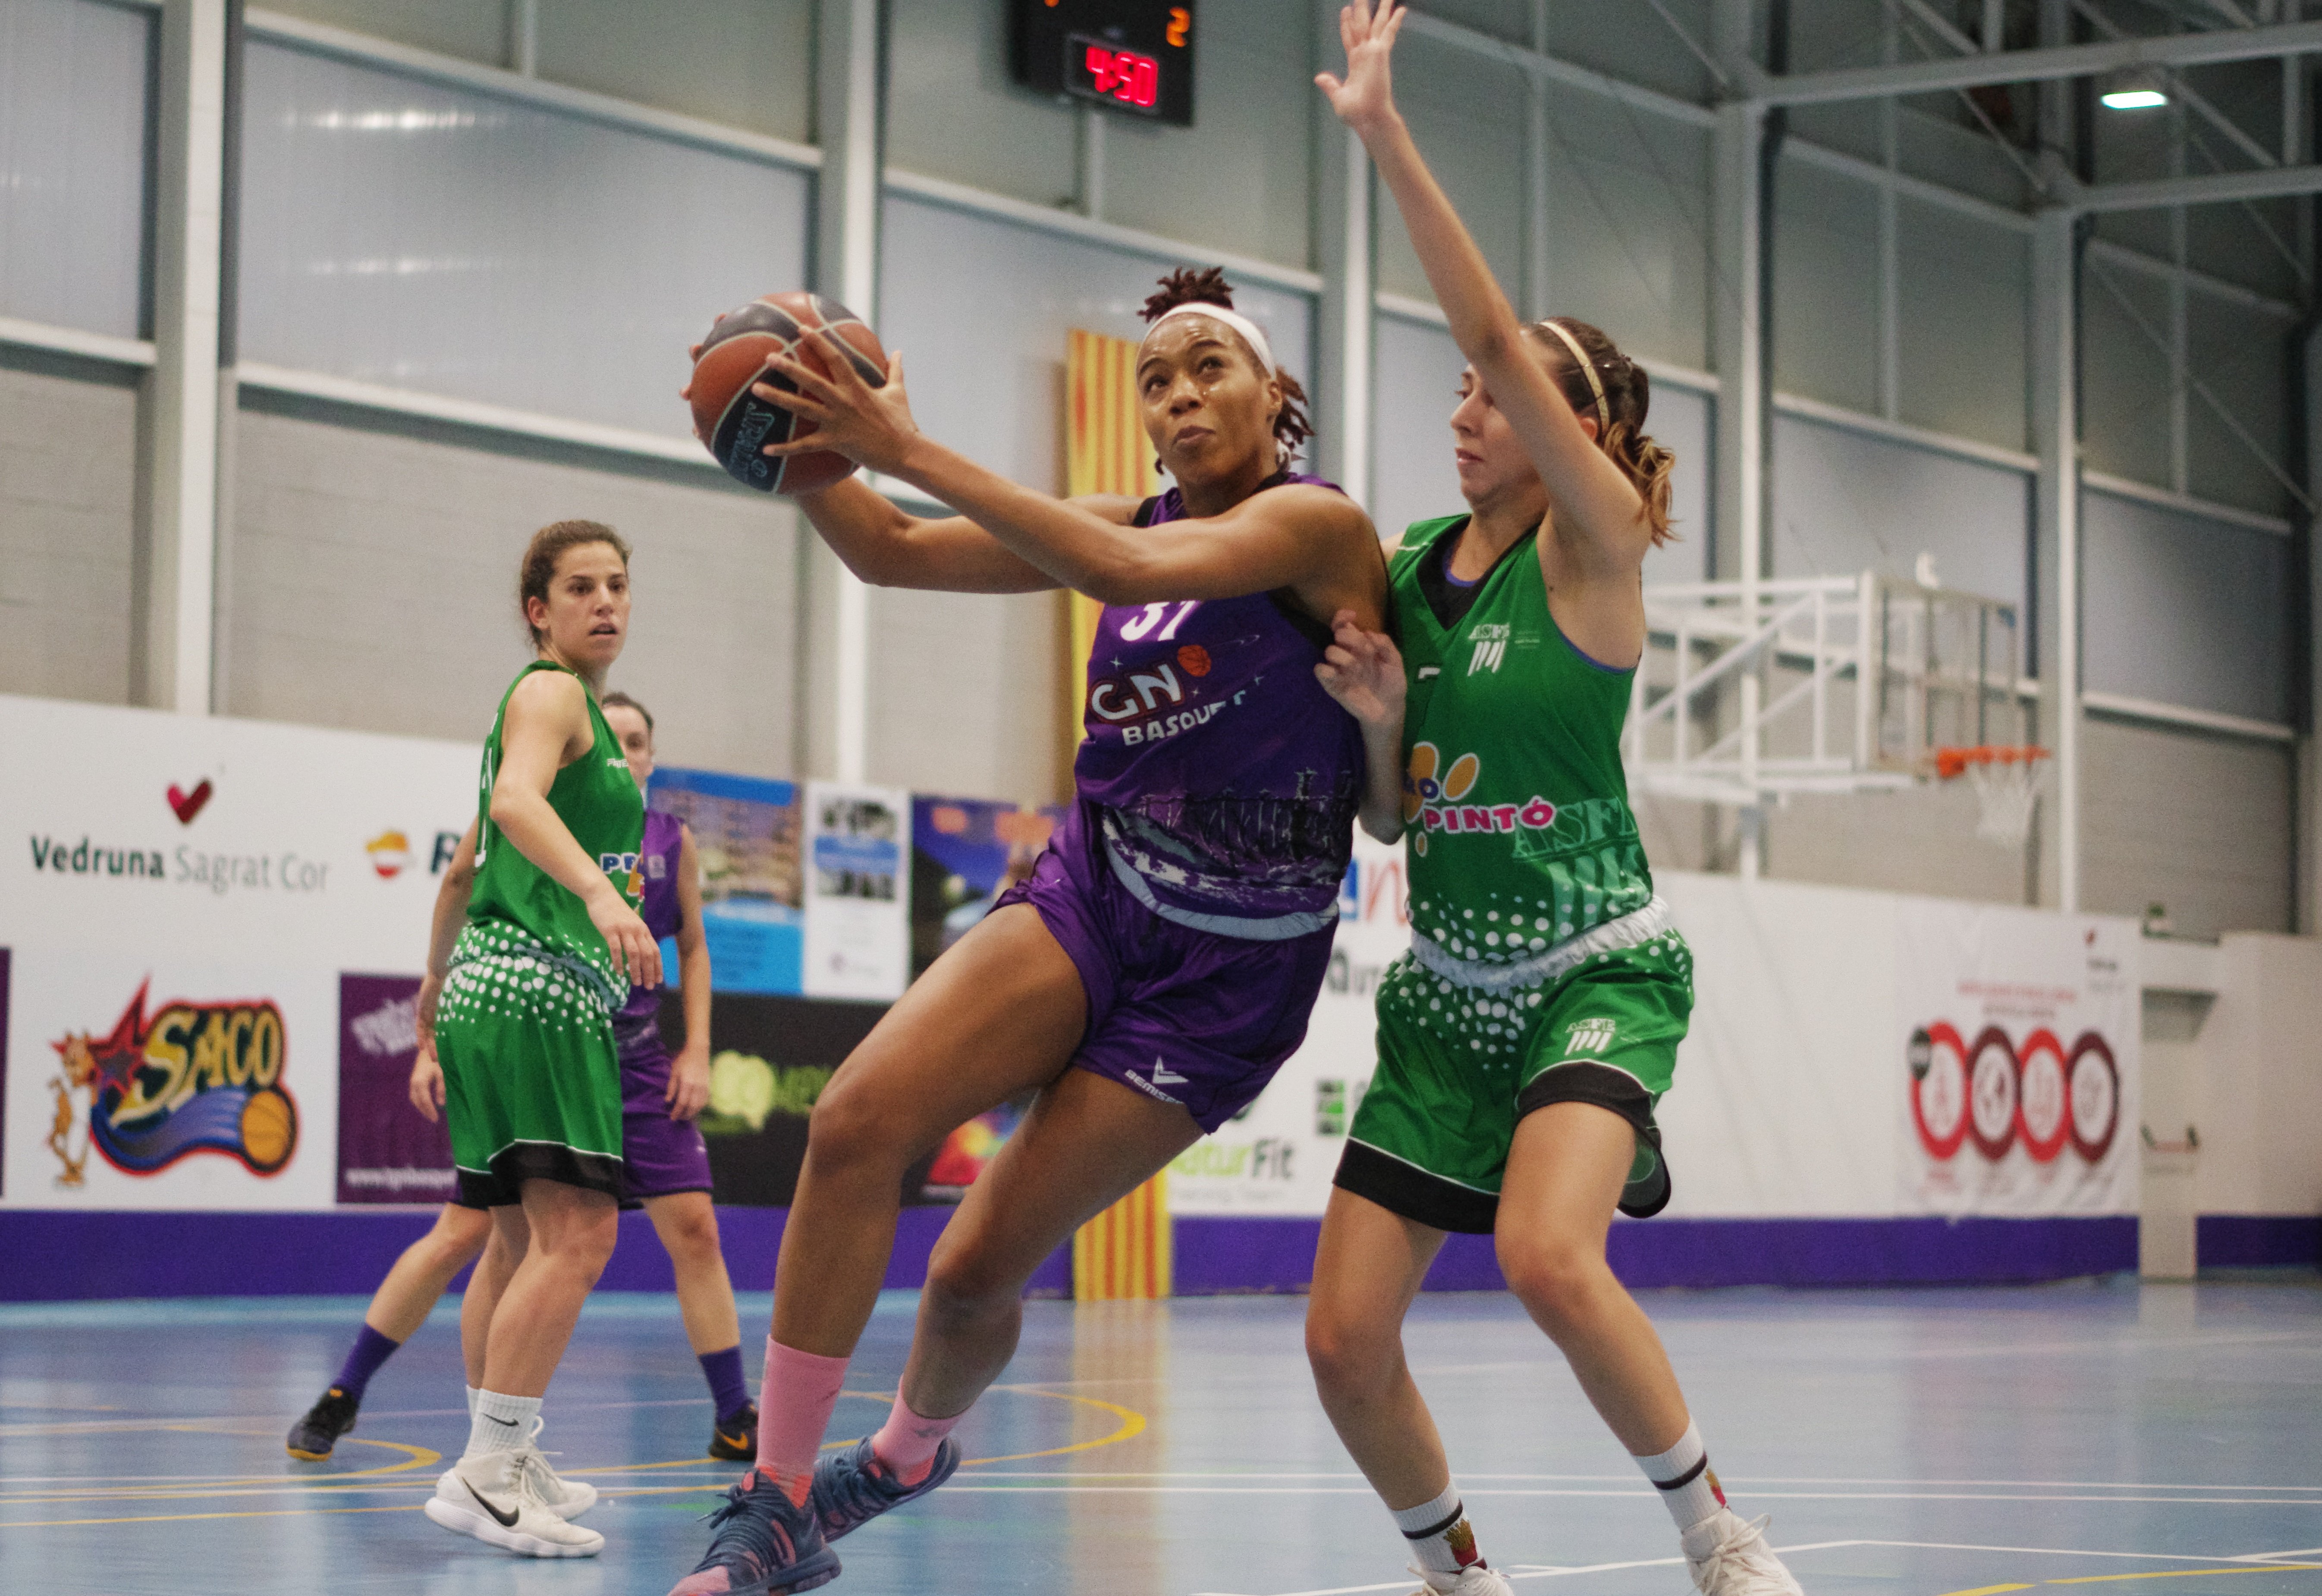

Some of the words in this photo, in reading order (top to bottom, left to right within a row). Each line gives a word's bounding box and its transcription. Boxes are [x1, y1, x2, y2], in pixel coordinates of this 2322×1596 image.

[1423, 796, 1555, 834] PINTÓ
[31, 834, 166, 879] Vedruna
[175, 843, 270, 896] Sagrat
[279, 851, 329, 892] Cor
